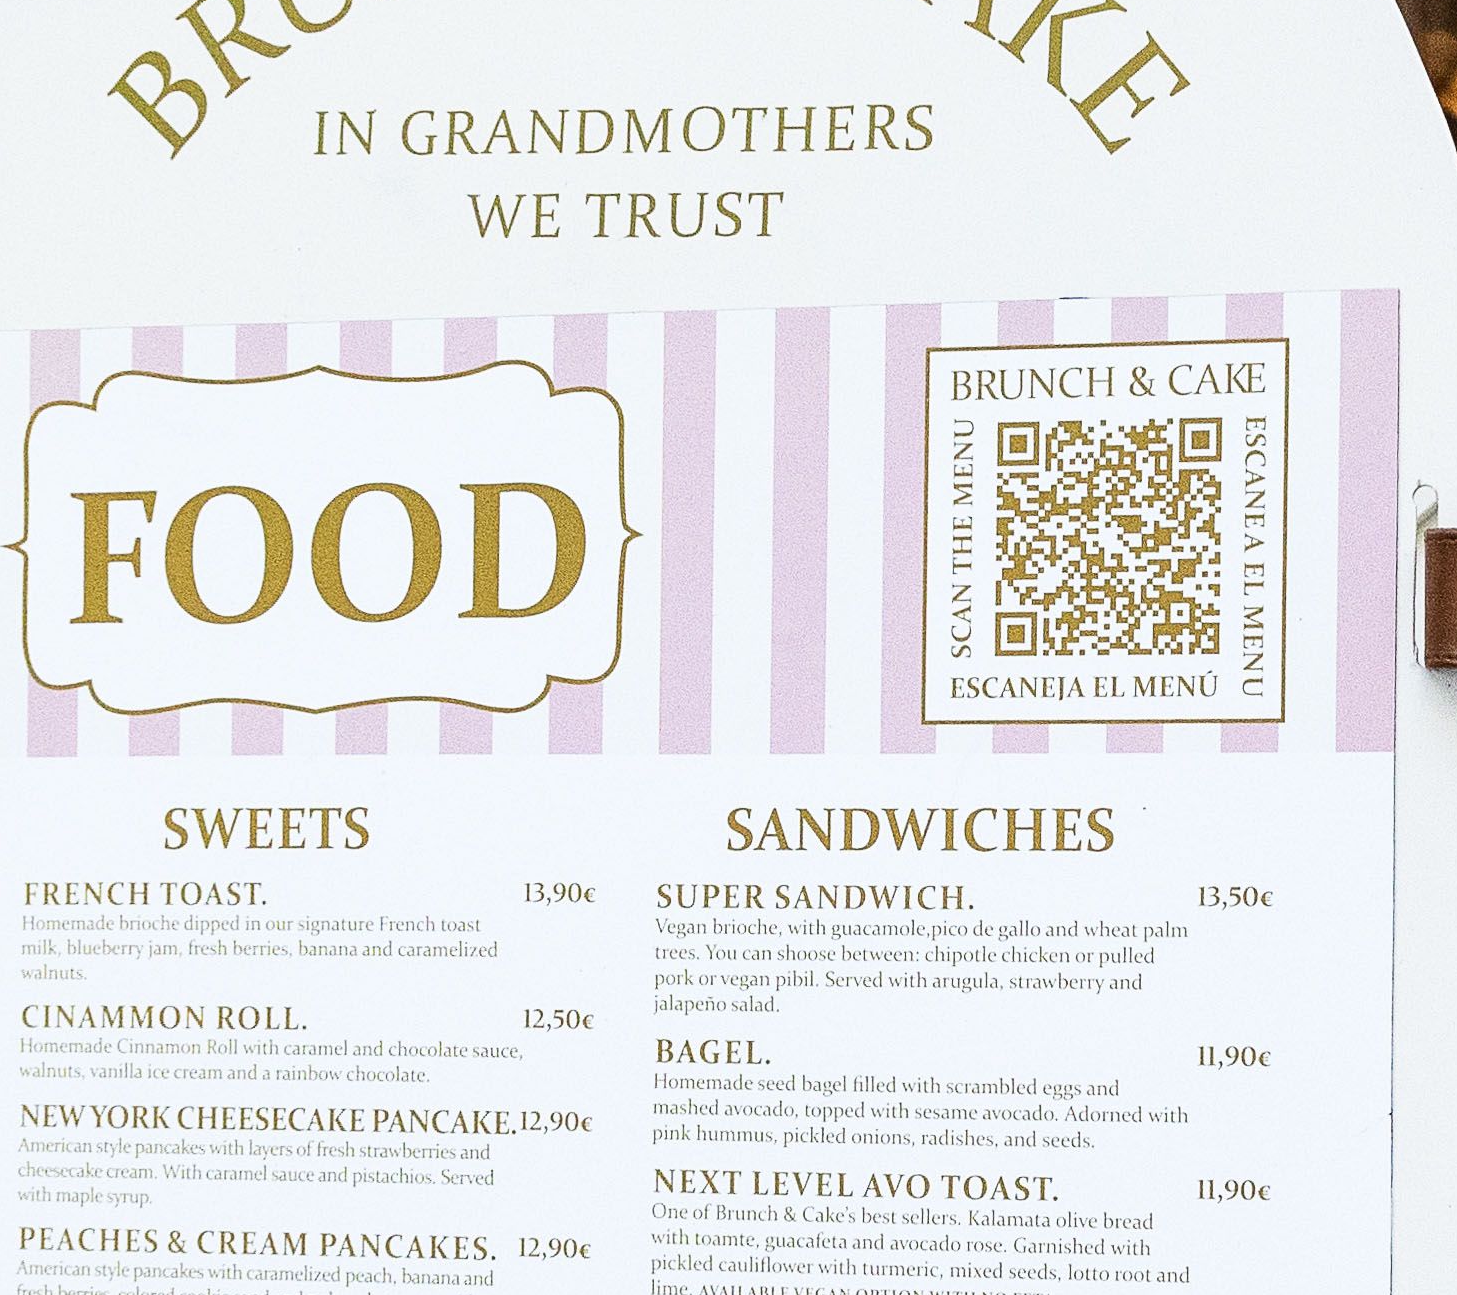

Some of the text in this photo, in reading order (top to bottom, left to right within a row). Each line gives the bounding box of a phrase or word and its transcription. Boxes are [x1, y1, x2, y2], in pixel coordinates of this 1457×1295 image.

[314, 104, 933, 156] IN GRANDMOTHERS
[468, 191, 784, 238] WE TRUST
[952, 362, 1266, 401] BRUNCH & CAKE
[69, 482, 586, 625] FOOD
[951, 419, 974, 658] SCAN THE MENU
[1242, 417, 1266, 696] ESCANEA EL MENU
[951, 670, 1217, 701] ESCANEJA EL MENÚ
[164, 806, 369, 850] SWEETS
[727, 807, 1114, 852] SANDWICHES
[25, 882, 595, 906] FRENCH TOAST. 13,90€
[657, 884, 1273, 910] SUPER SANDWICH. 13,50€
[655, 918, 707, 939] Vegan
[713, 918, 782, 936] brioche,
[788, 919, 826, 935] with
[972, 920, 994, 937] de
[998, 920, 1041, 941] gallo
[1045, 920, 1078, 937] and
[1084, 920, 1137, 938] wheat
[1144, 921, 1188, 943] palm
[22, 1005, 593, 1031] CINAMMON ROLL. 12,50€
[657, 1039, 1271, 1068] BAGEL. 11,90€
[177, 1106, 364, 1132] CHEESECAKE
[373, 1109, 516, 1135] PANCAKE.
[522, 1111, 592, 1133] 12,90€
[655, 1169, 1270, 1202] NEXT LEVEL AVO TOAST. 11,90€
[20, 1227, 590, 1261] PEACHES & CREAM PANCAKES. 12,90€
